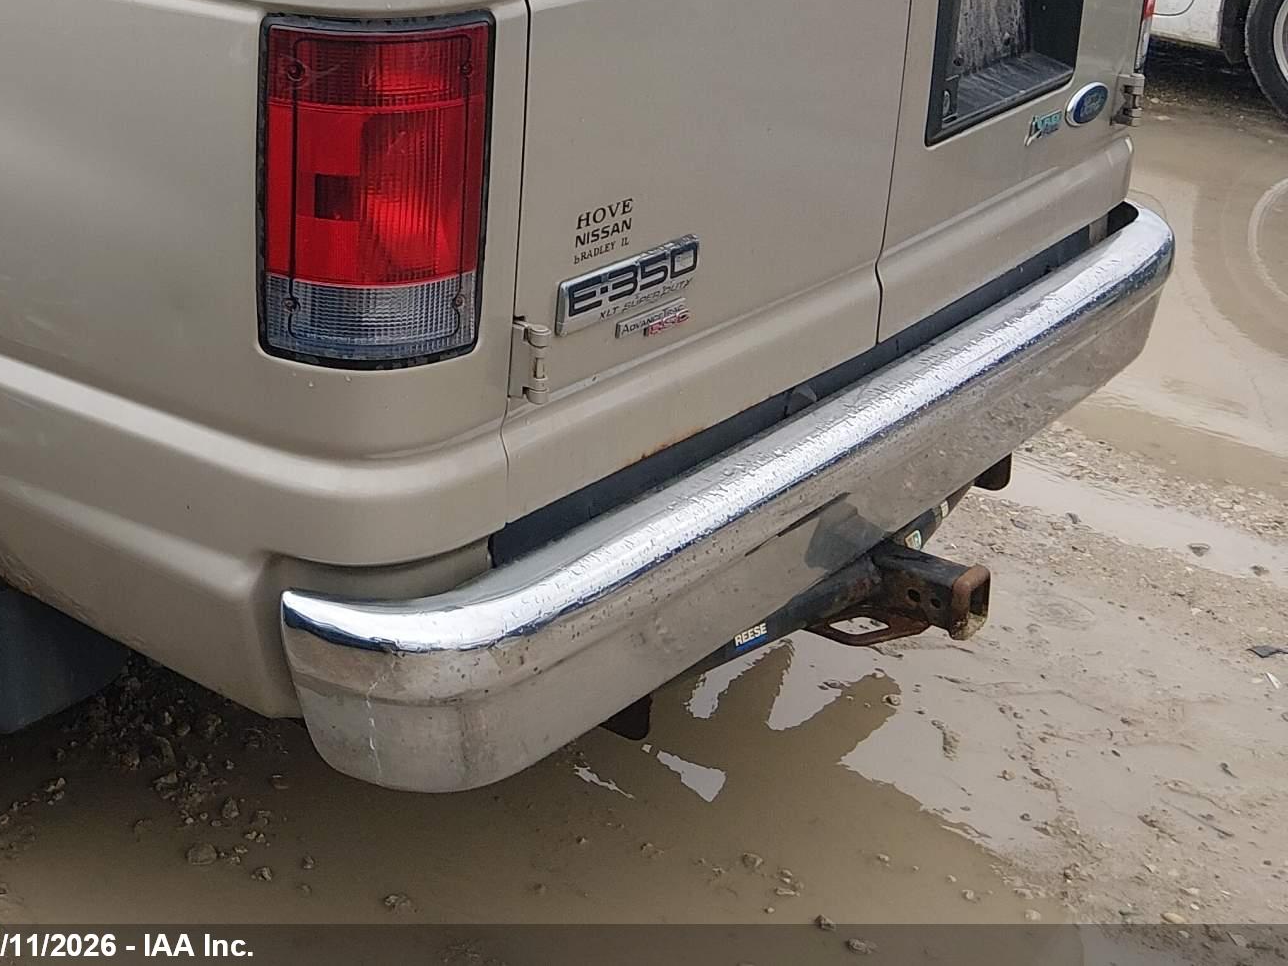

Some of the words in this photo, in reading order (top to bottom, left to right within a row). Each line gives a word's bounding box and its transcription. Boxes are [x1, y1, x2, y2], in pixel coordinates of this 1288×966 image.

[576, 198, 634, 230] HOVE
[576, 218, 632, 249] NISSAN
[621, 237, 630, 247] IL
[734, 622, 768, 647] REESE
